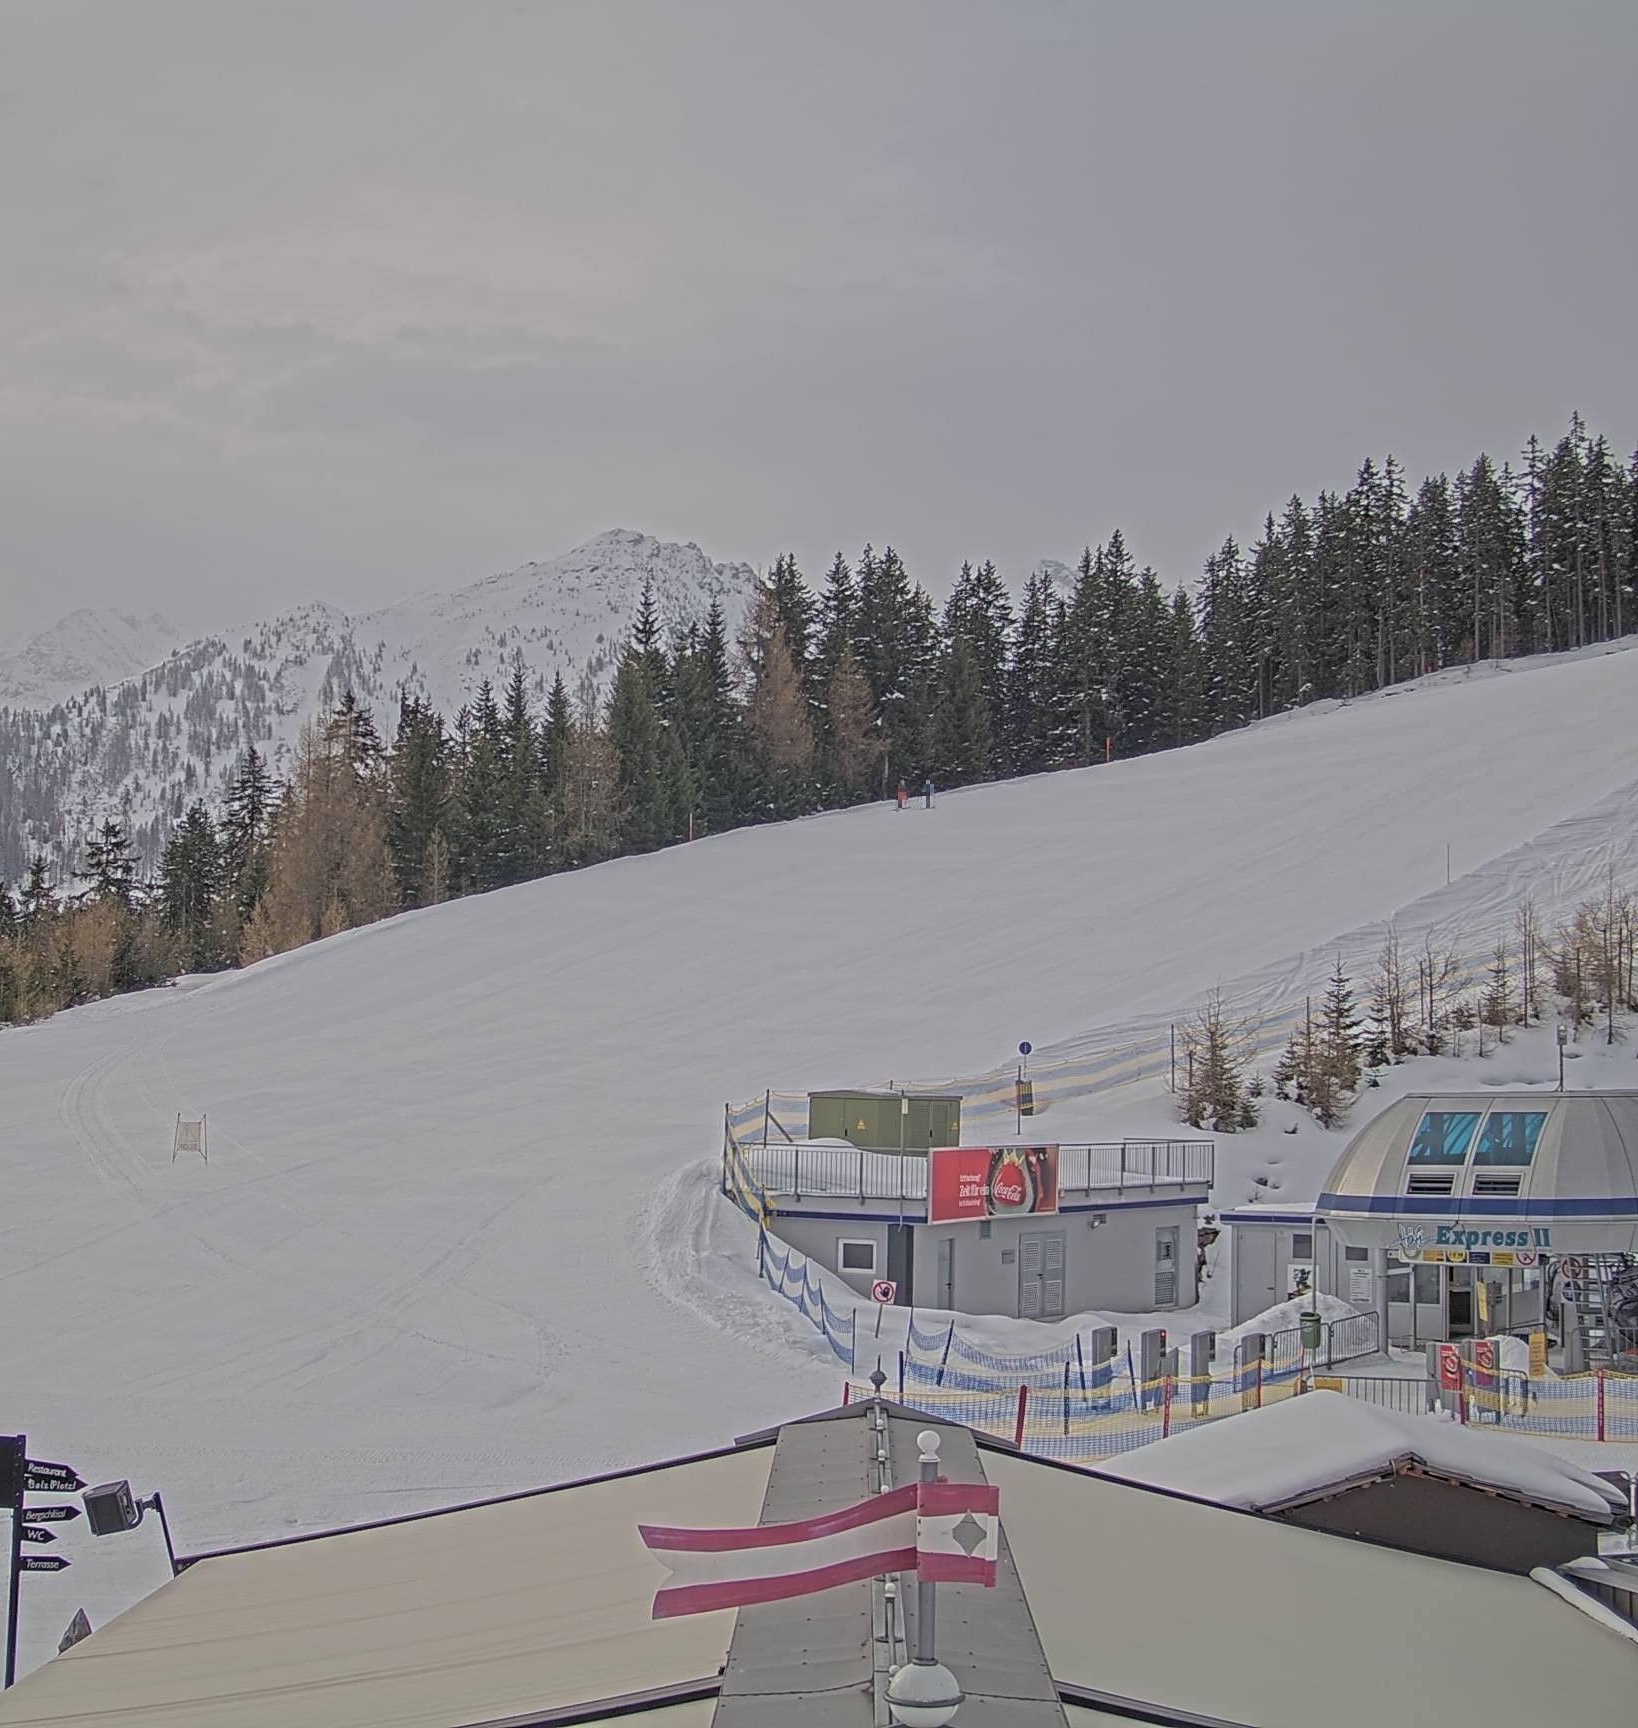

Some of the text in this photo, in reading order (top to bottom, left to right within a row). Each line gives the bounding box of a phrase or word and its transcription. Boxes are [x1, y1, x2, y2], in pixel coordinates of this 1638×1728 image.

[1436, 1225, 1529, 1250] Express
[1532, 1227, 1551, 1248] II
[27, 1462, 67, 1478] Restaurant
[27, 1529, 45, 1541] WC
[26, 1559, 60, 1569] Terrasse
